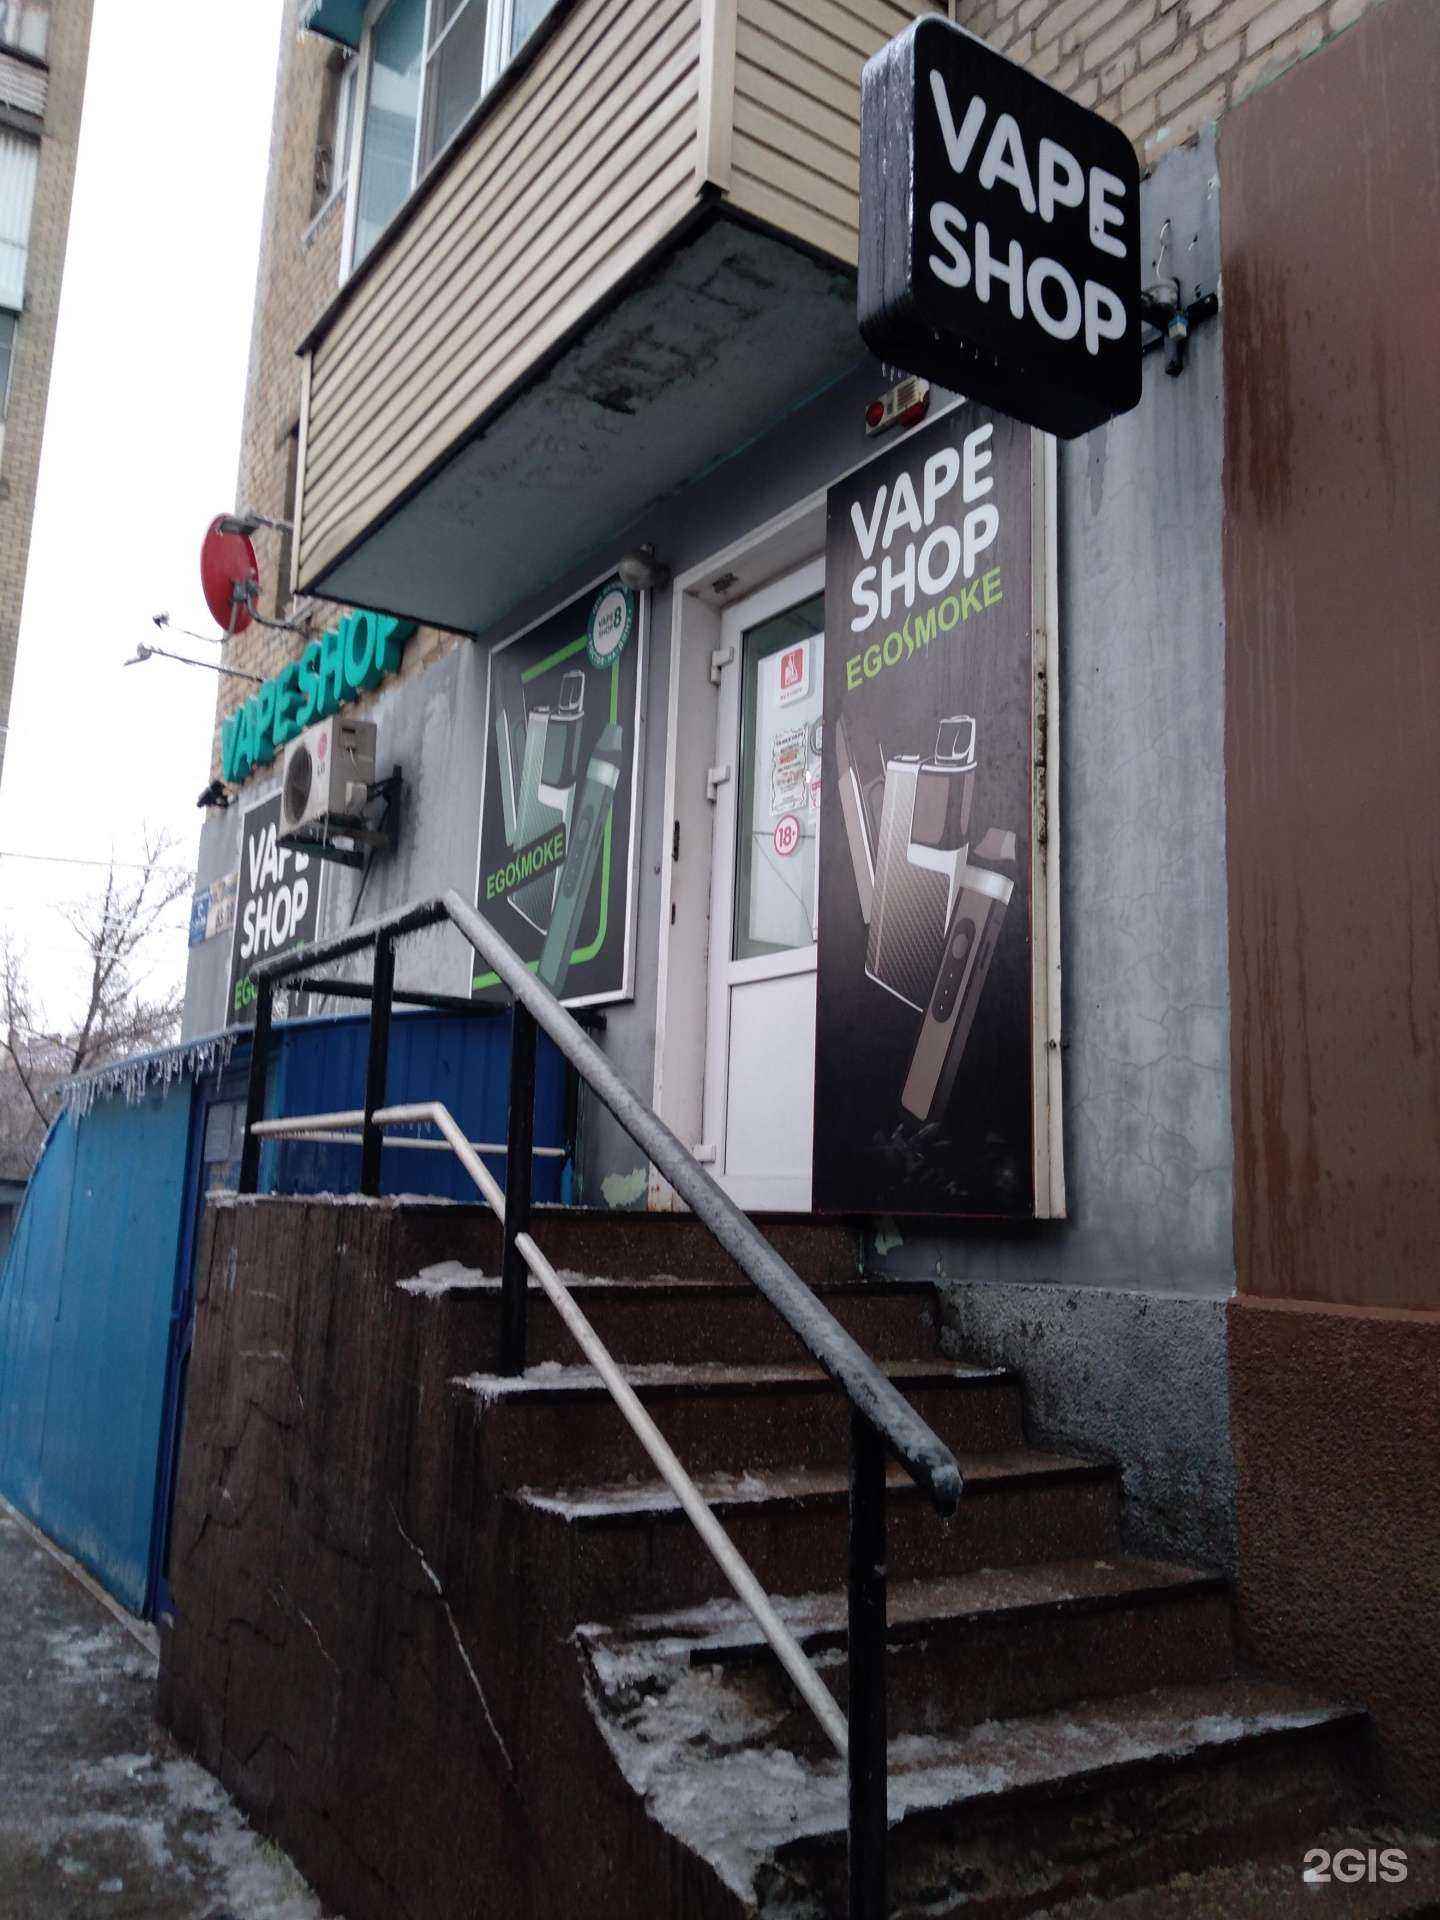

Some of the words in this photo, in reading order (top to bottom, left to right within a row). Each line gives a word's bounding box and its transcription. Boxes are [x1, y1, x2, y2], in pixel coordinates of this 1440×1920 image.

[930, 69, 1127, 258] VAPE
[929, 201, 1127, 356] SHOP
[850, 422, 994, 560] VAPE
[846, 566, 1003, 691] EGOSMOKE
[850, 503, 999, 633] SHOP
[241, 877, 309, 960] SHOP
[487, 832, 564, 900] EGOSMOKE
